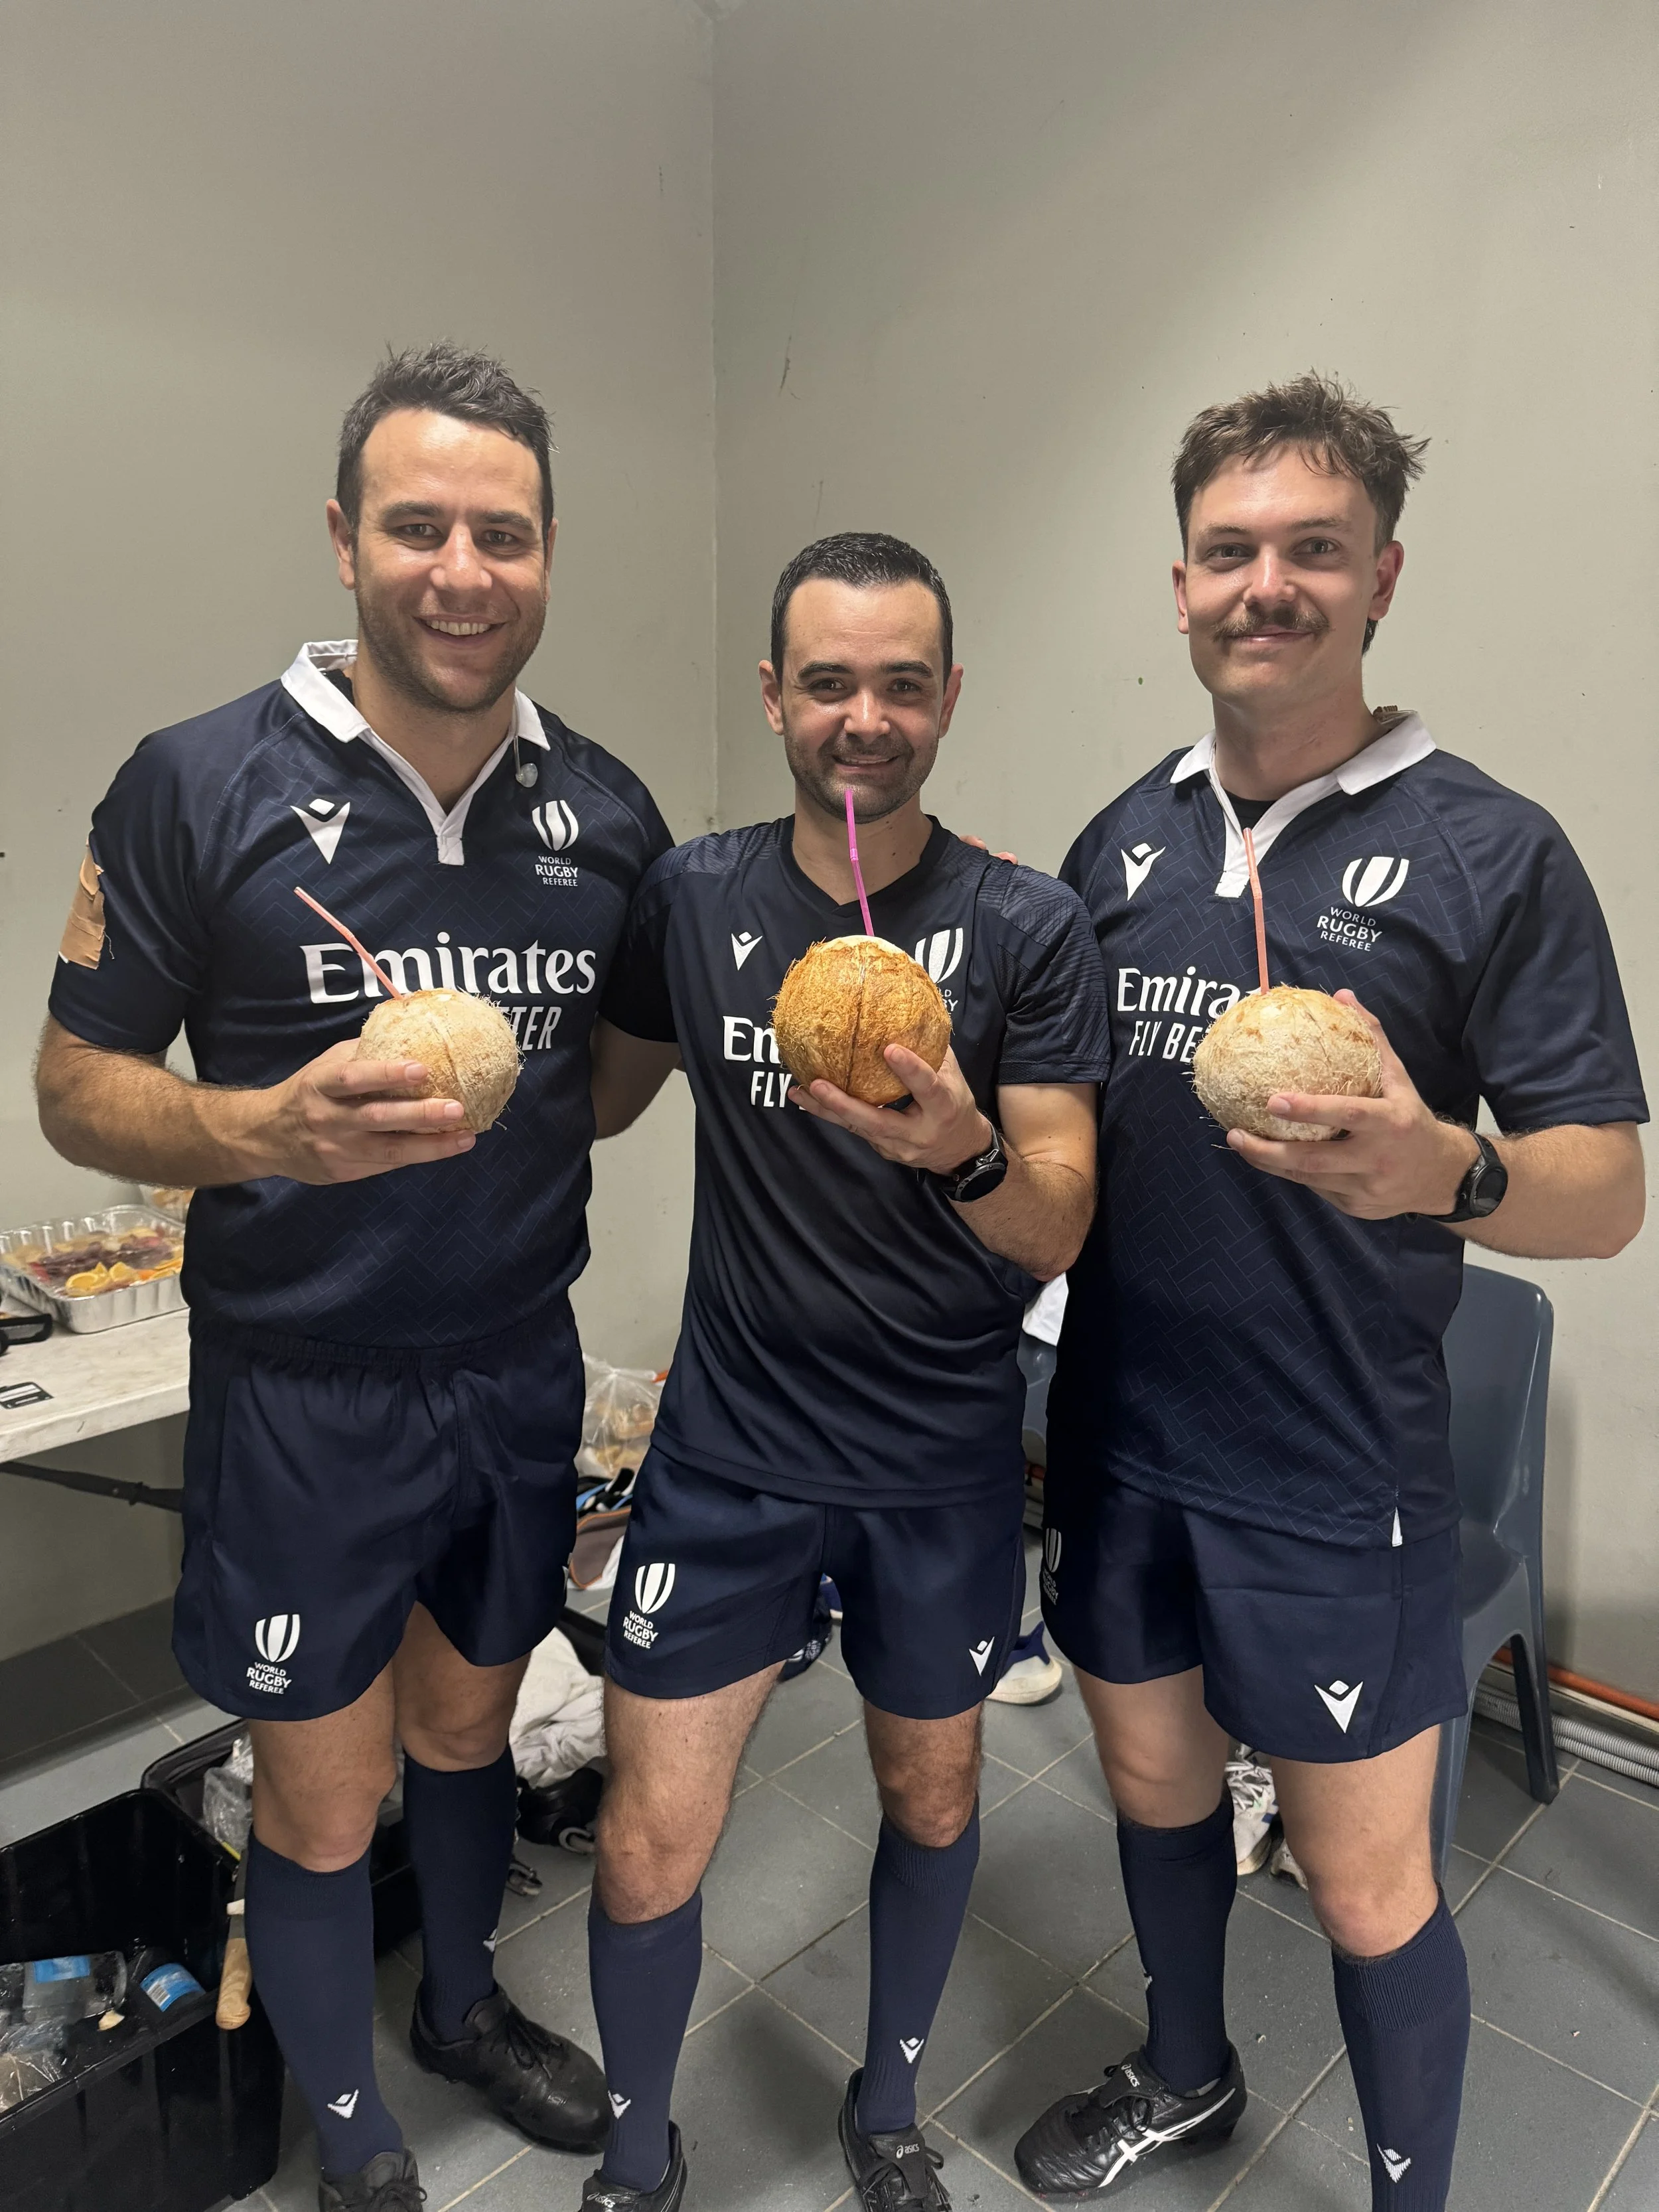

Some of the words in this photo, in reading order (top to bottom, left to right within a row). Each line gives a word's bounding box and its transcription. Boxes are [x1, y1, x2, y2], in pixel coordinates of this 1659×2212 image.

[538, 855, 571, 865] WORLD
[535, 864, 579, 878] RUGBY
[542, 877, 579, 887] REFEREE
[1331, 907, 1376, 926] WORLD
[1317, 915, 1383, 942] RUGBY
[1320, 930, 1372, 952] REFEREE
[299, 931, 596, 1004] Emirates
[1117, 966, 1262, 1019] Emira
[1128, 1021, 1162, 1056] FLY
[751, 1070, 792, 1108] FLY
[623, 1616, 659, 1642] RUGBY
[629, 1610, 654, 1629] WORLD
[624, 1629, 651, 1649] REFEREE
[246, 1667, 292, 1689] RUGBY
[254, 1662, 286, 1677] WORLD
[249, 1680, 284, 1694] REFEREE
